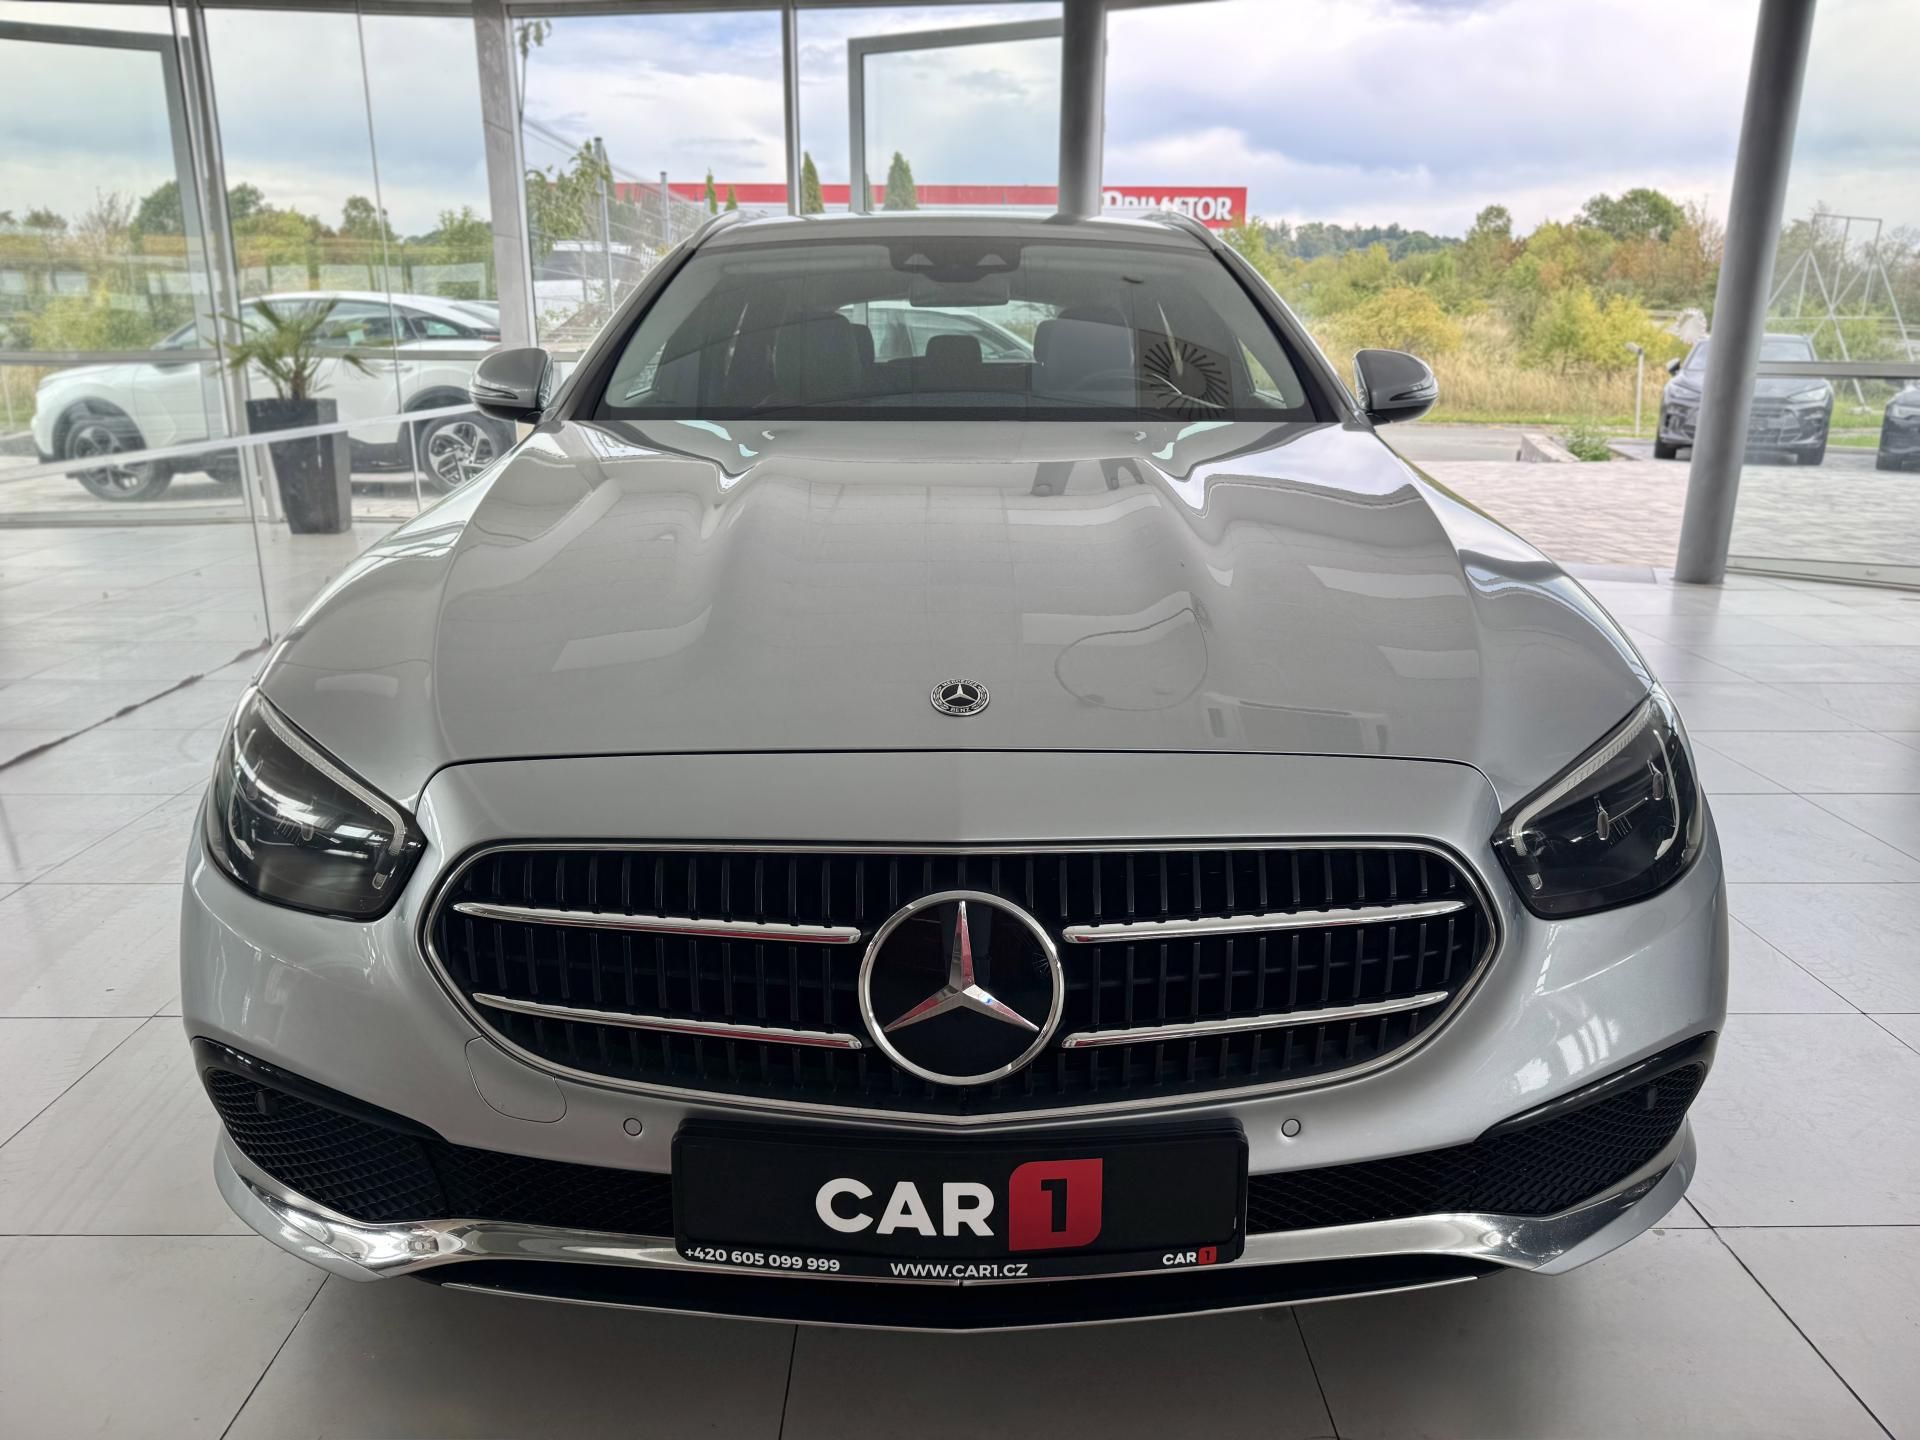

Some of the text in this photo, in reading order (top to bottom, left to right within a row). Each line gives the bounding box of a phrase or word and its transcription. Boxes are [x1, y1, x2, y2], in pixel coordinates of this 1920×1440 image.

[815, 1177, 1068, 1236] CAR 1
[685, 1247, 840, 1272] +420 605 099 999
[1162, 1251, 1197, 1265] CAR
[890, 1262, 1029, 1278] WWW.CAR1.CZ
